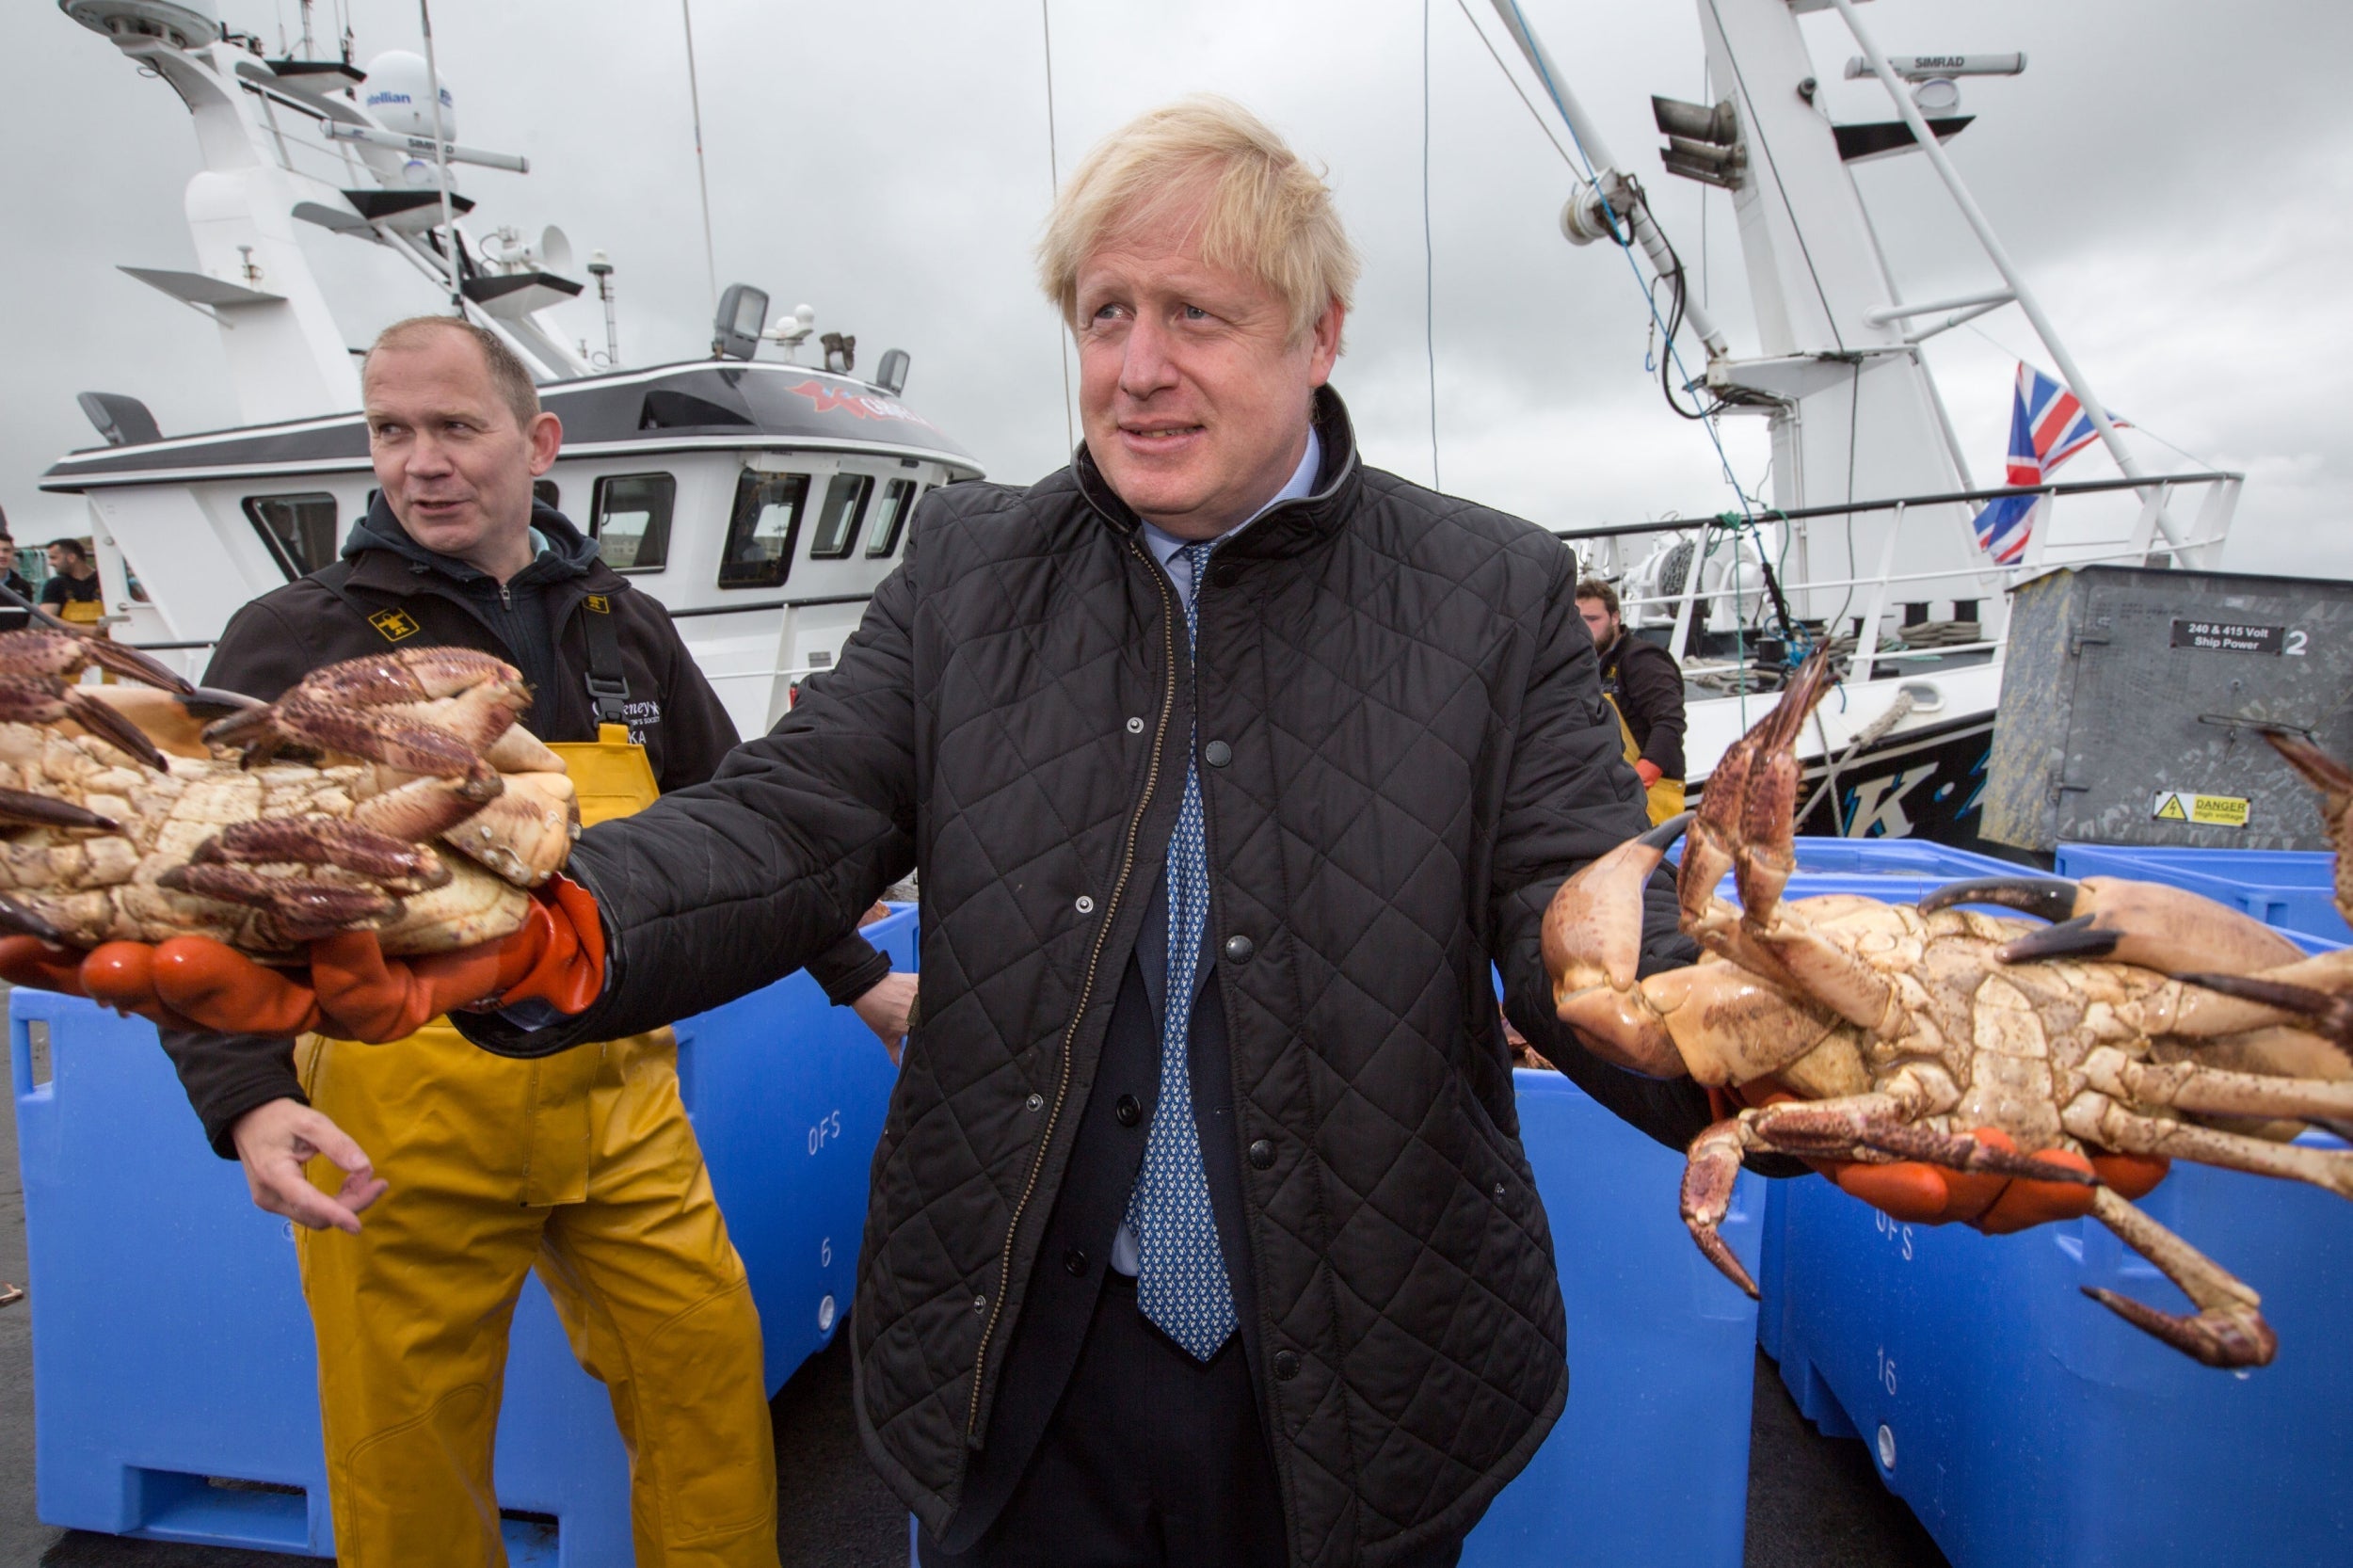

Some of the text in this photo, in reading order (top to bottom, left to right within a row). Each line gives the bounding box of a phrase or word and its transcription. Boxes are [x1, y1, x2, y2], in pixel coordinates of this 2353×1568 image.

[1914, 56, 1965, 69] SIMRAD
[408, 137, 455, 154] SIMRD
[2188, 623, 2269, 638] 240 & 415 Volt
[2194, 636, 2259, 649] Ship Power
[2286, 631, 2308, 655] 2
[2196, 799, 2246, 811] DANGER
[2195, 810, 2213, 819] High
[821, 1237, 832, 1268] 6
[1877, 1347, 1897, 1396] 16
